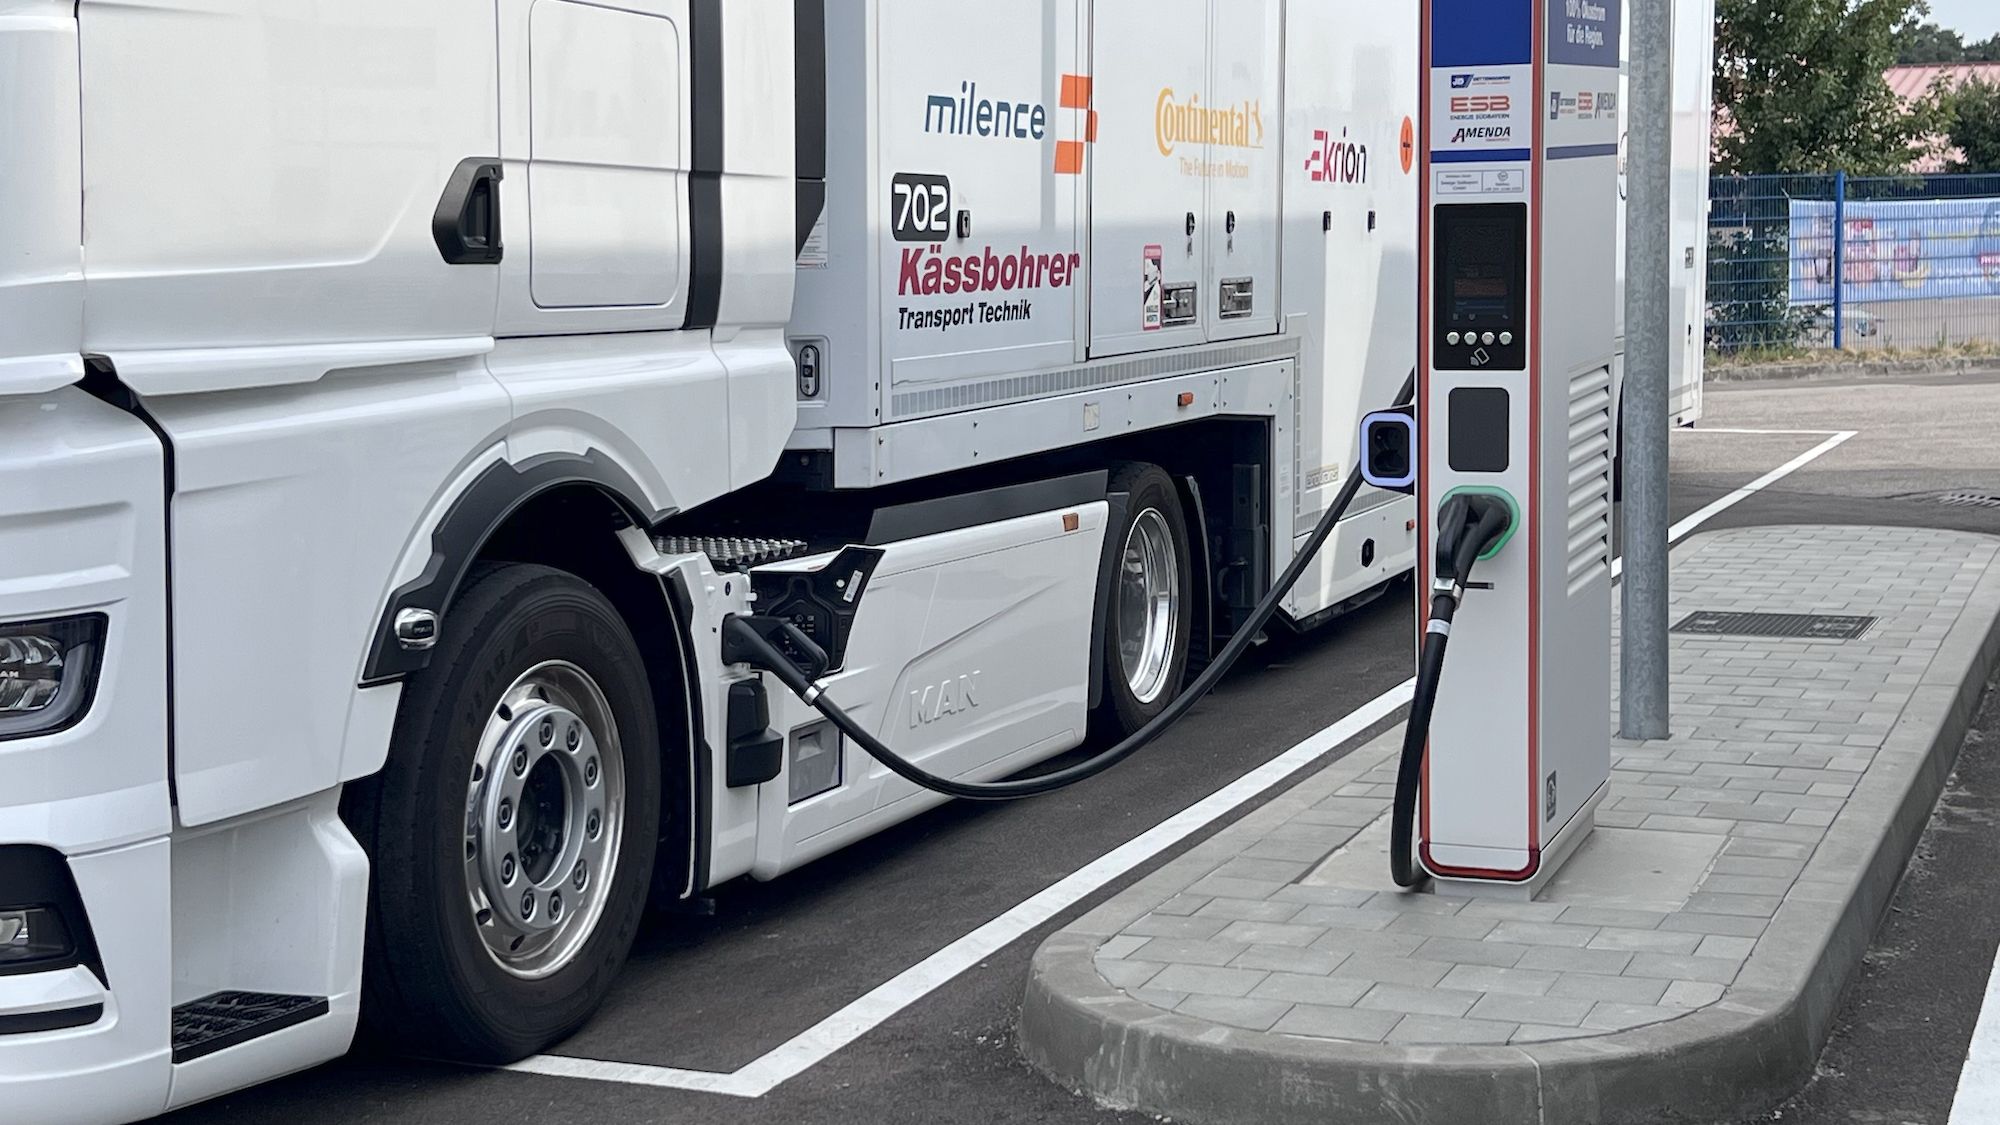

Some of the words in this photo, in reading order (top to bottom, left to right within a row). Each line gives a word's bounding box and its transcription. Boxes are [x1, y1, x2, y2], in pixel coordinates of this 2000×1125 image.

[925, 81, 1046, 140] milence
[1155, 87, 1250, 156] Continental
[1451, 96, 1510, 112] ESB
[1451, 126, 1511, 143] AMENDA
[894, 183, 948, 232] 702
[898, 244, 1080, 296] Kässbohrer
[898, 302, 974, 331] Transport
[978, 299, 1032, 323] Technik
[0, 670, 19, 678] AN
[909, 669, 981, 730] MAN
